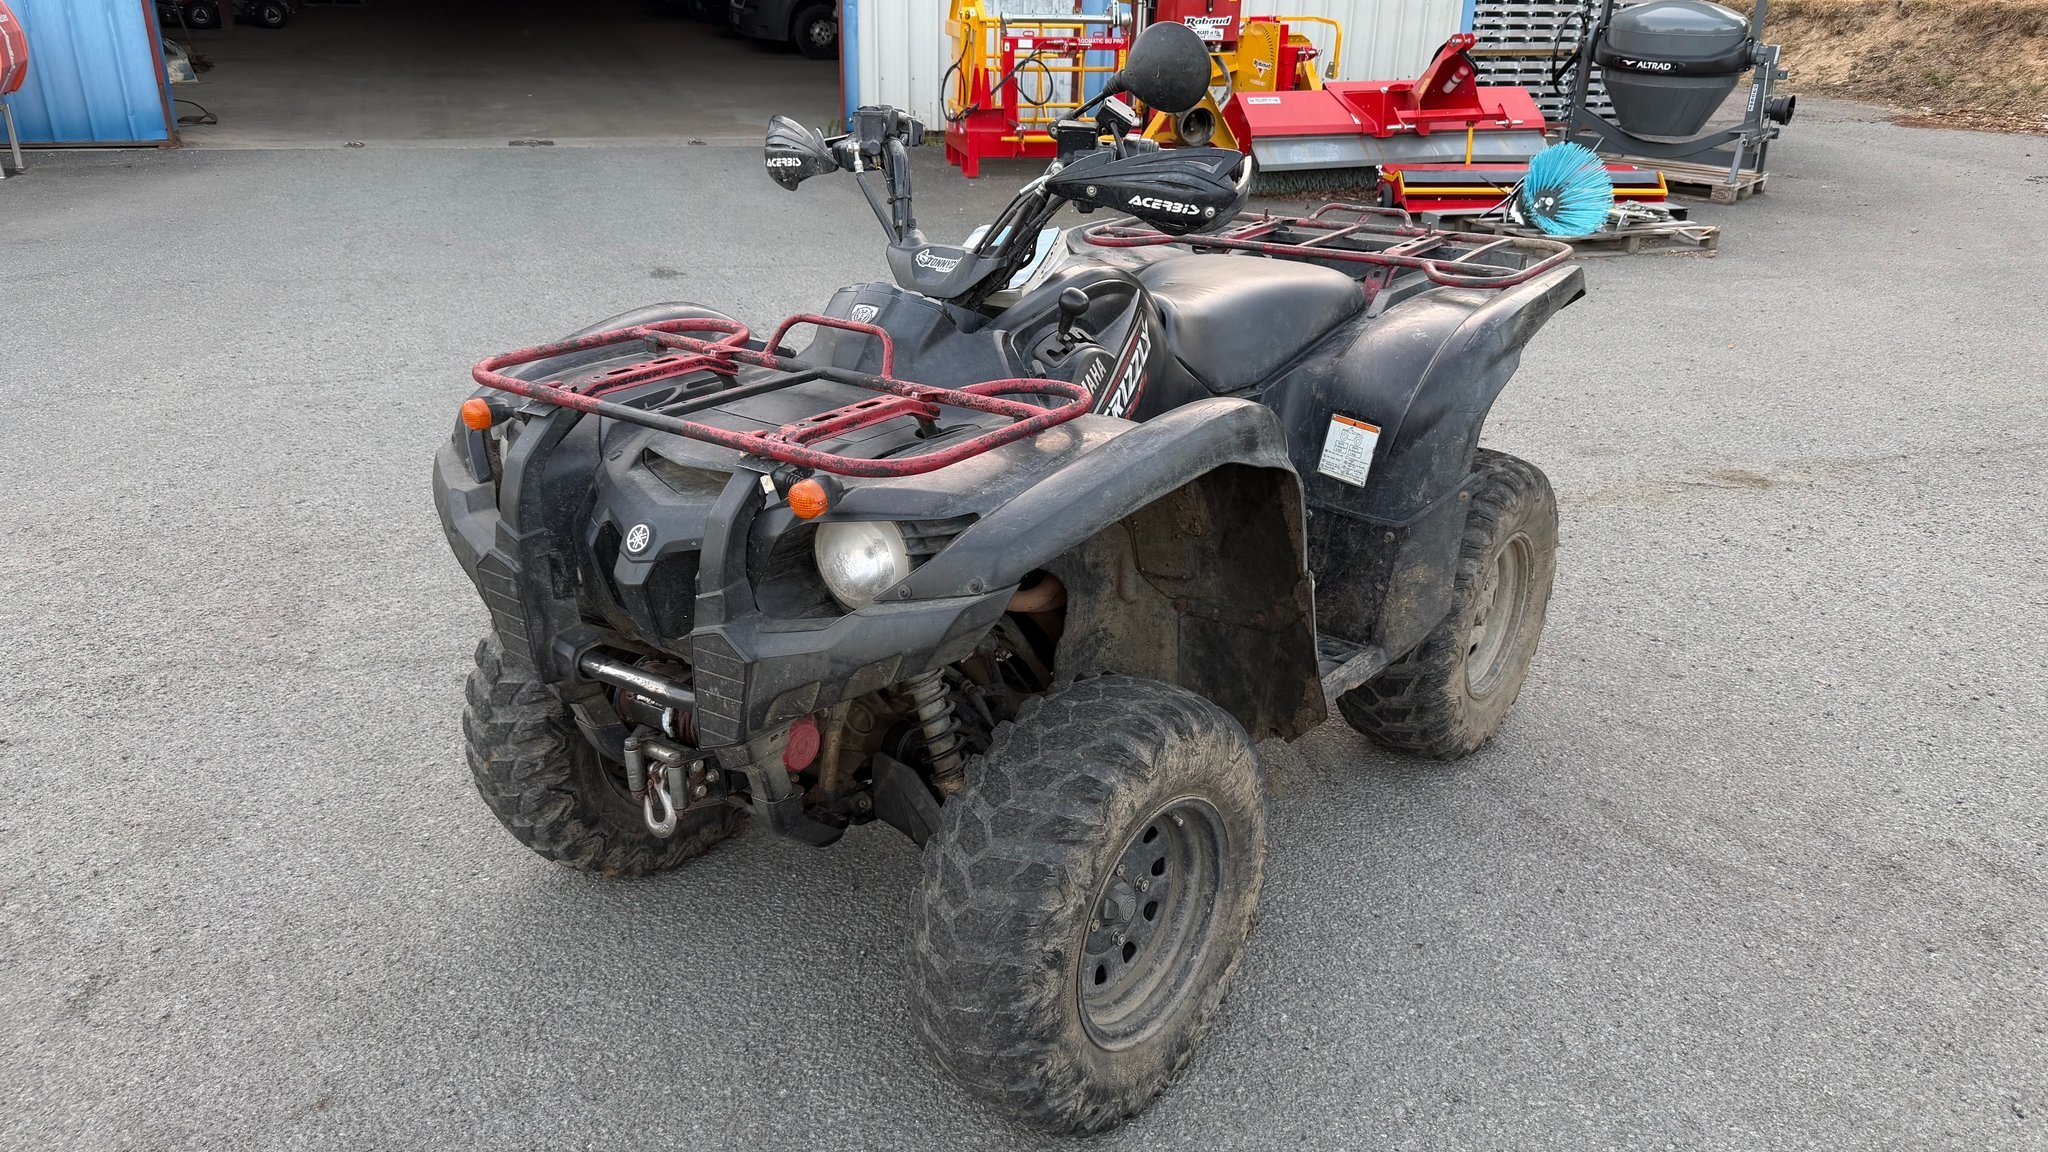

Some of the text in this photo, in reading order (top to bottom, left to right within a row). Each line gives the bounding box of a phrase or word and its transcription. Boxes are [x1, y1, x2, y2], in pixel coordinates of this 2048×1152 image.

[1185, 16, 1231, 27] Rabaud
[1636, 60, 1672, 71] ALTRAD
[766, 157, 802, 167] ACERBIS
[1127, 195, 1201, 215] ACERBIS
